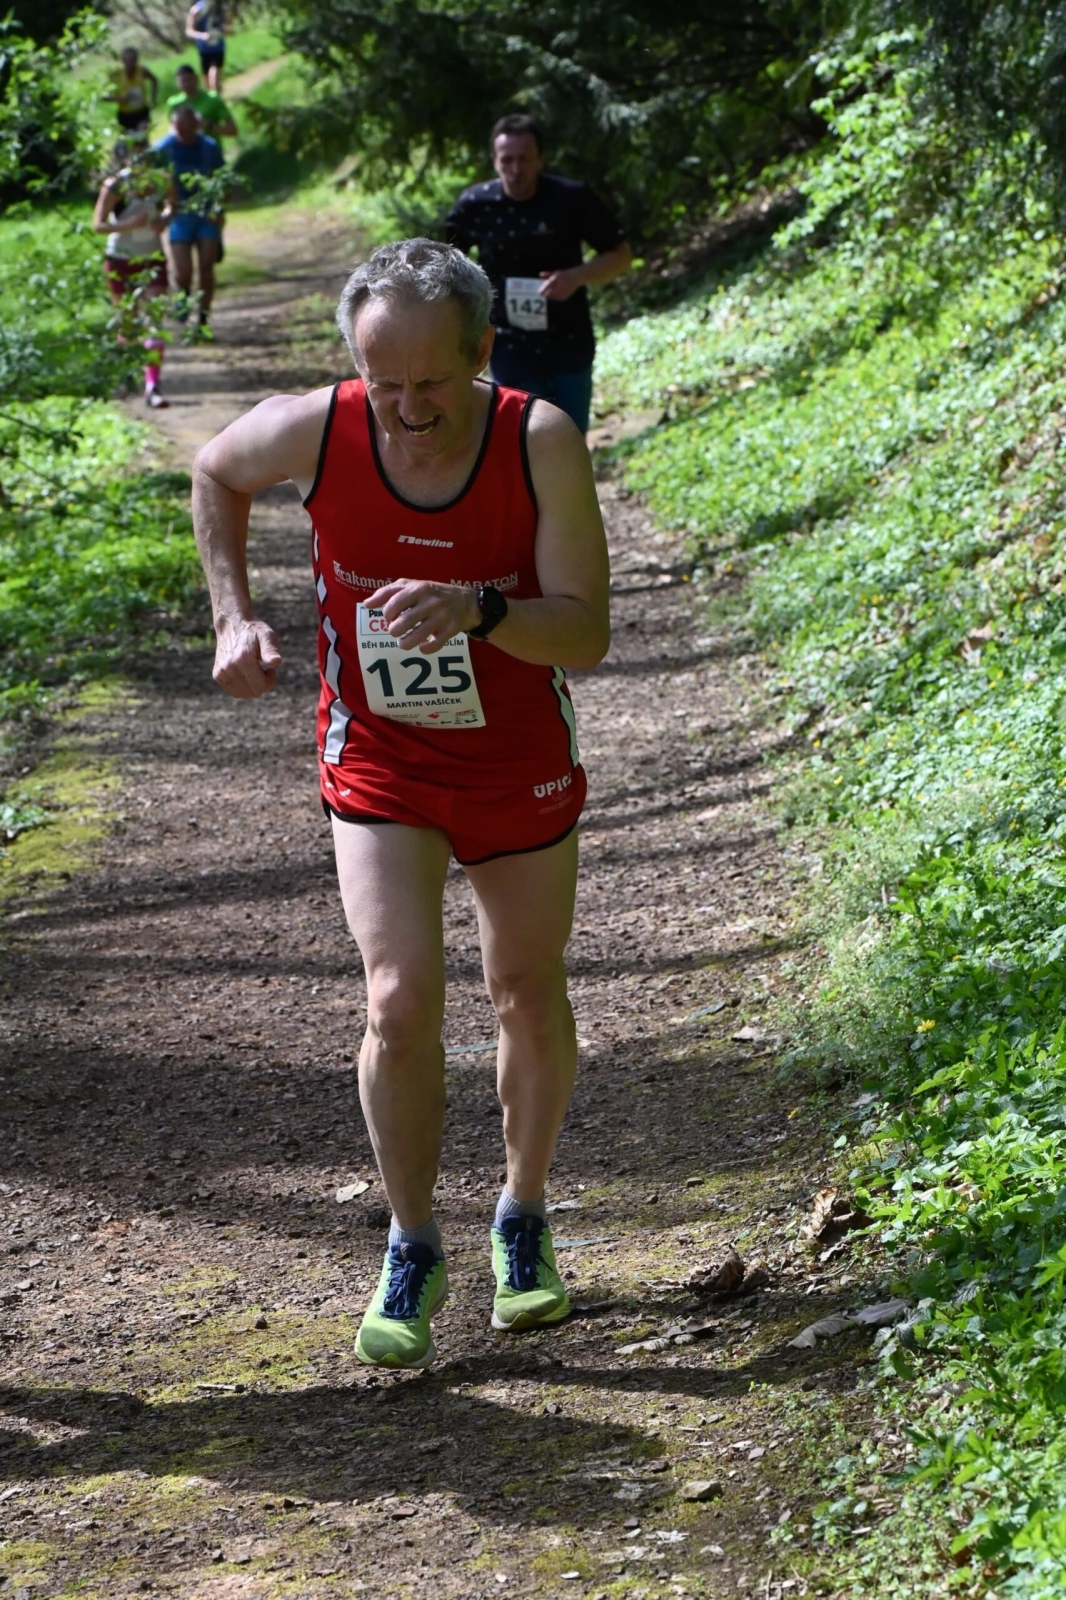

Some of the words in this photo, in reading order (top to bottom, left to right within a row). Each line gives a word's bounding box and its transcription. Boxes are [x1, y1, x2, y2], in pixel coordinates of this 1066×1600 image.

[509, 298, 546, 314] 142
[450, 571, 518, 589] MARATON
[361, 640, 378, 649] BĚH
[366, 656, 472, 697] 125
[387, 701, 423, 709] MARTIN
[424, 698, 462, 706] VAŠÍČEK
